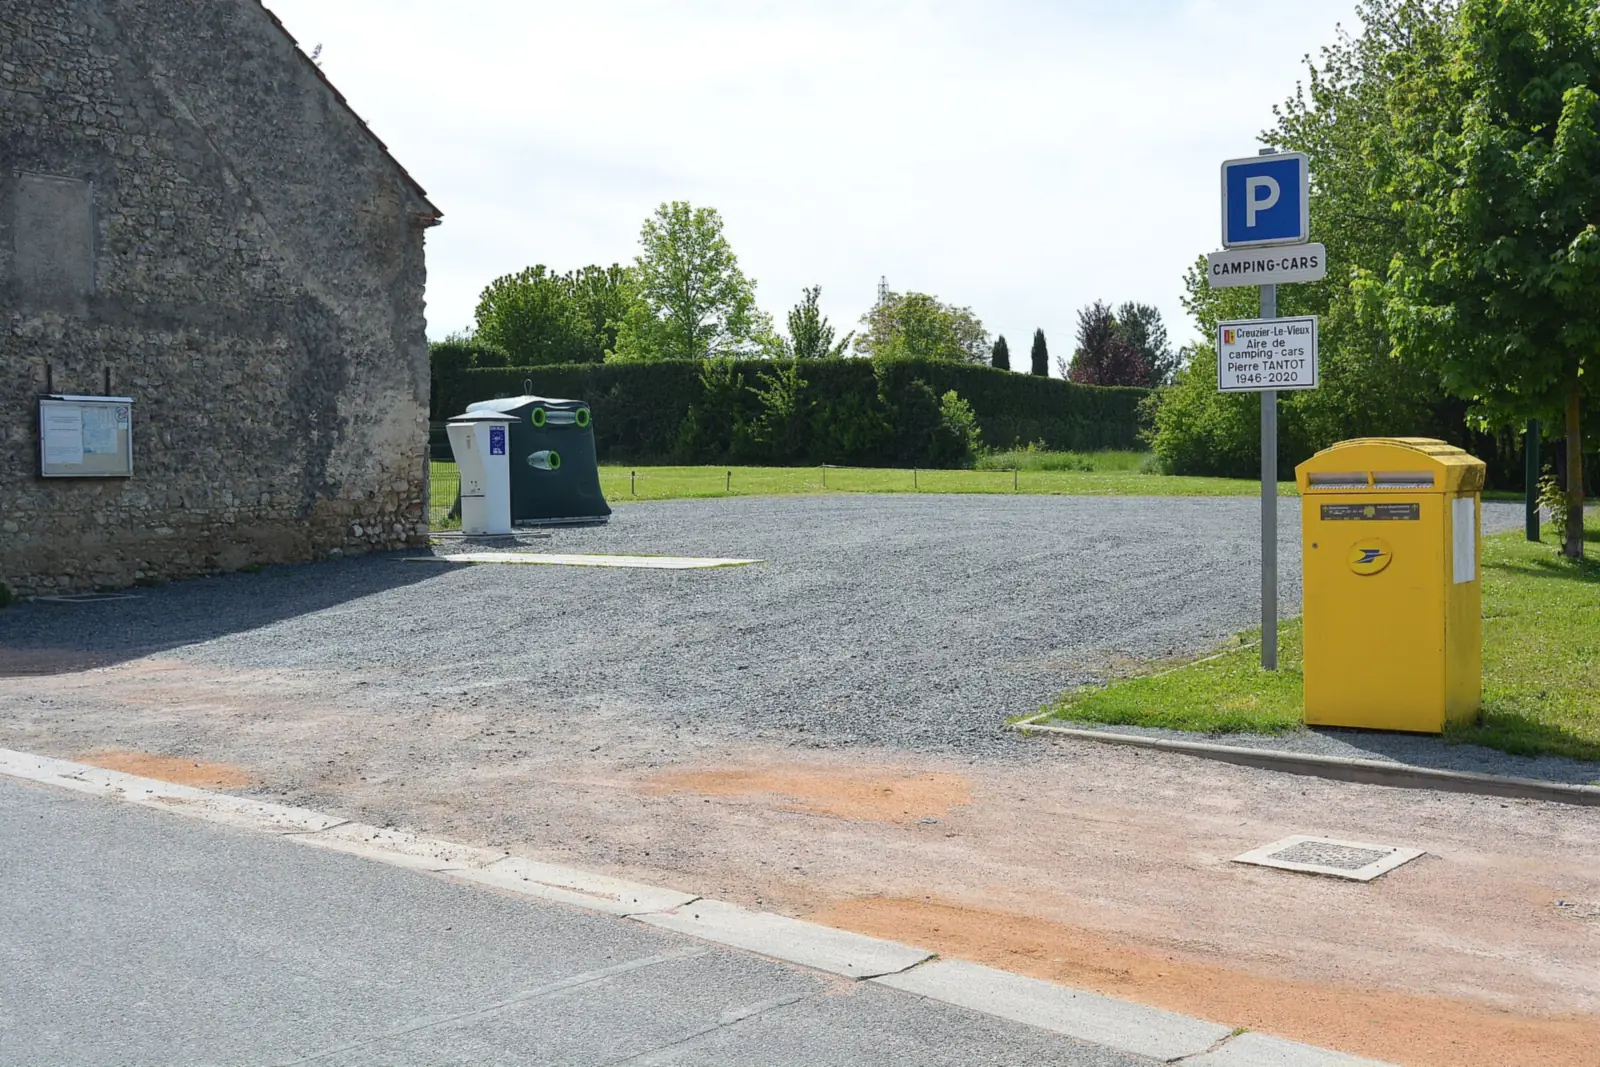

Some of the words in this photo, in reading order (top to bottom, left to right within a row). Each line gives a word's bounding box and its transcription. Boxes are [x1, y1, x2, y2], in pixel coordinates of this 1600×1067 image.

[1245, 175, 1281, 228] P
[1212, 255, 1319, 276] CAMPING-CARS
[1236, 325, 1310, 338] Creuzier-Le-Vieux
[1246, 339, 1267, 349] Aire
[1272, 338, 1286, 348] de
[1227, 362, 1259, 372] Pierre
[1262, 359, 1305, 371] TANTOT
[1235, 371, 1298, 384] 1946-2020
